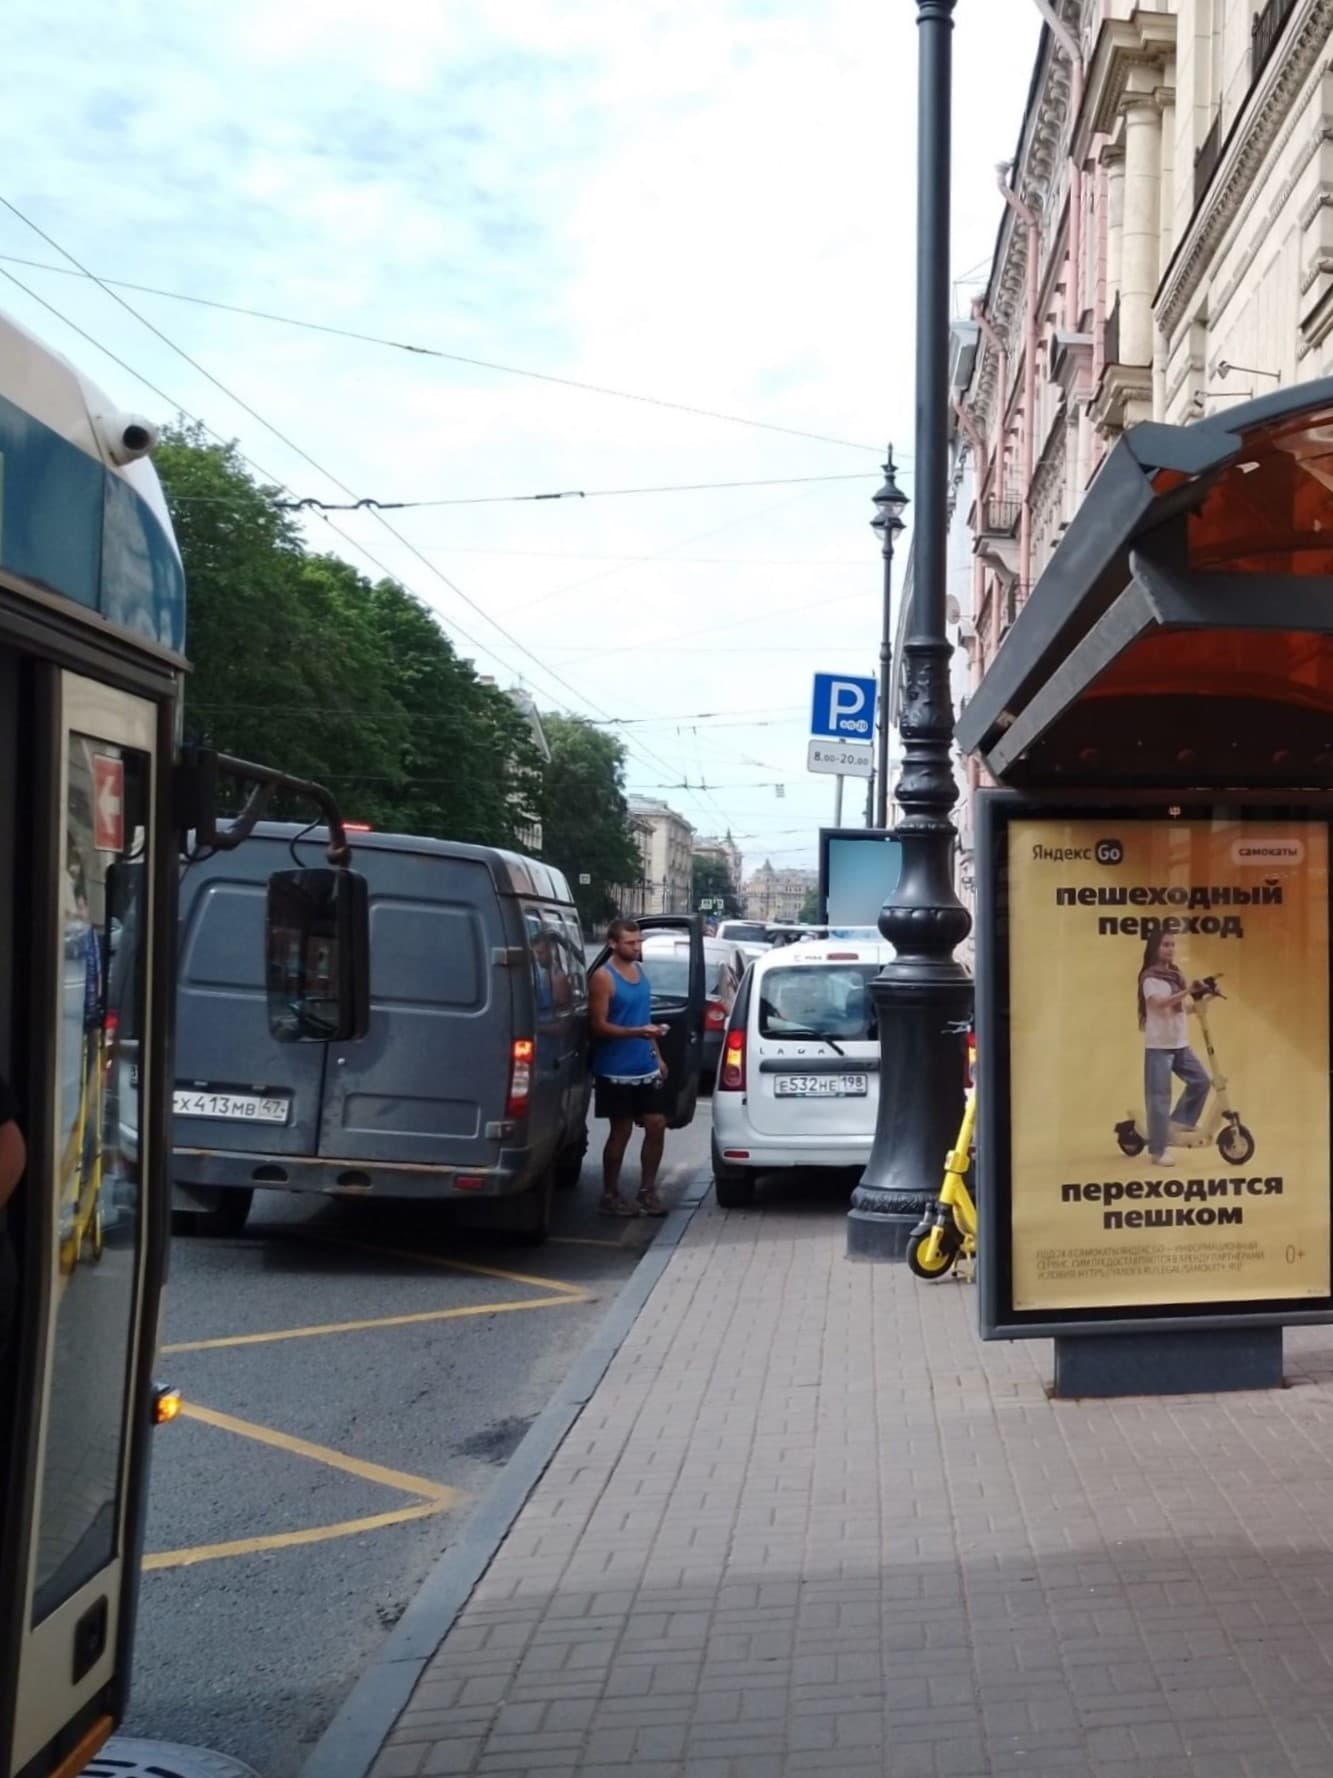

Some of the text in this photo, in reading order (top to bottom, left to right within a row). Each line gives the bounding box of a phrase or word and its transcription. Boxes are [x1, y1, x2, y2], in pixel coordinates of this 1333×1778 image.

[828, 681, 865, 730] P
[1032, 843, 1120, 862] Яндекс Go
[1238, 847, 1298, 857] самокаты
[1056, 878, 1283, 910] пешеходный
[1098, 914, 1244, 940] переход
[1061, 1177, 1283, 1205] переходится
[1103, 1206, 1243, 1229] пешком
[1285, 1244, 1305, 1264] 0+
